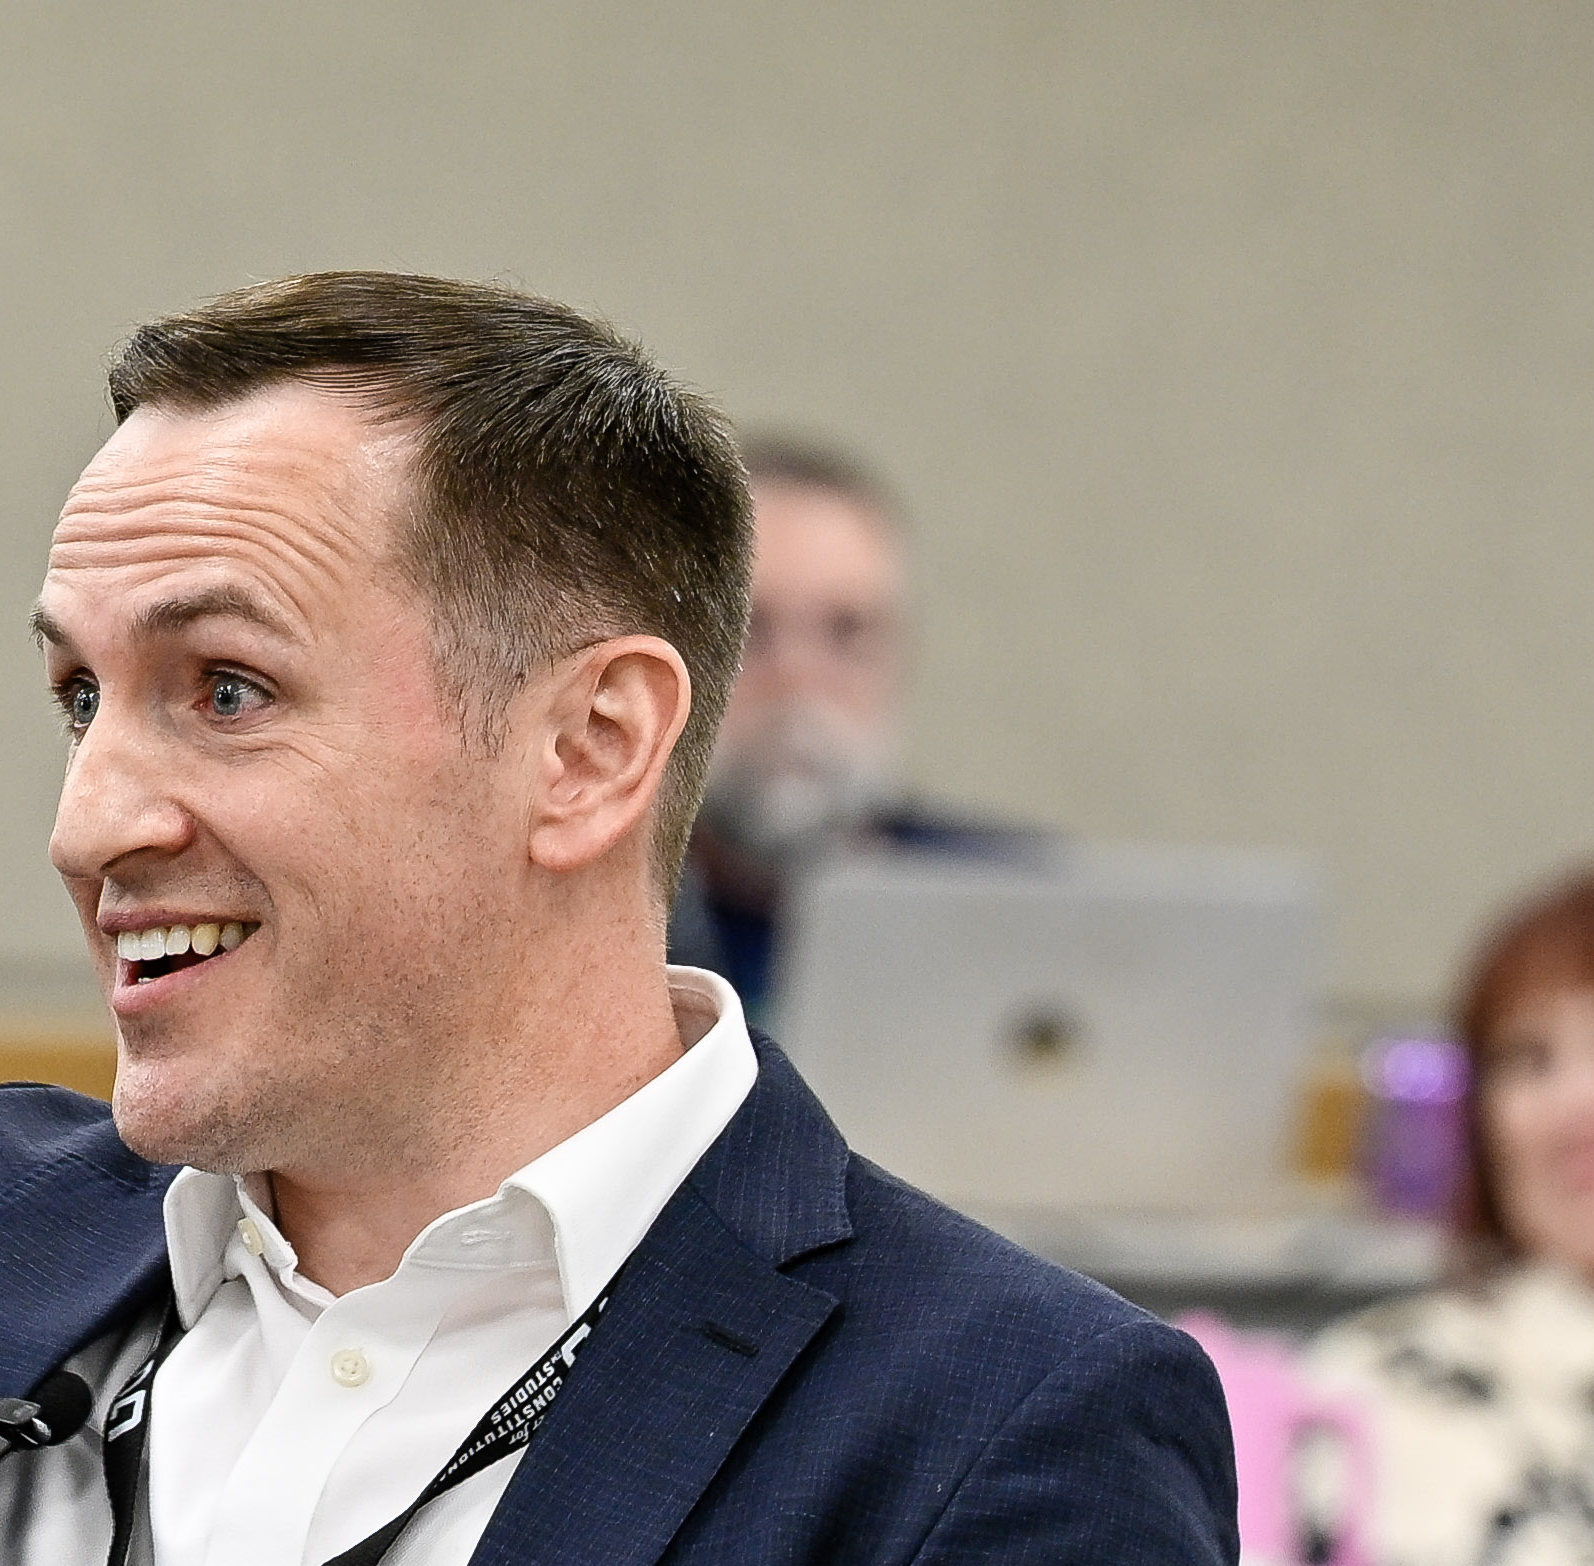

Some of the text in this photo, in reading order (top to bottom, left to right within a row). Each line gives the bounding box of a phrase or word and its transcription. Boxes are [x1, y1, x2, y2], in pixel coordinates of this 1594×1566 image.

[491, 1361, 556, 1425] STUDIES
[433, 1376, 563, 1488] CONSTITUTION
[509, 1422, 530, 1444] for
